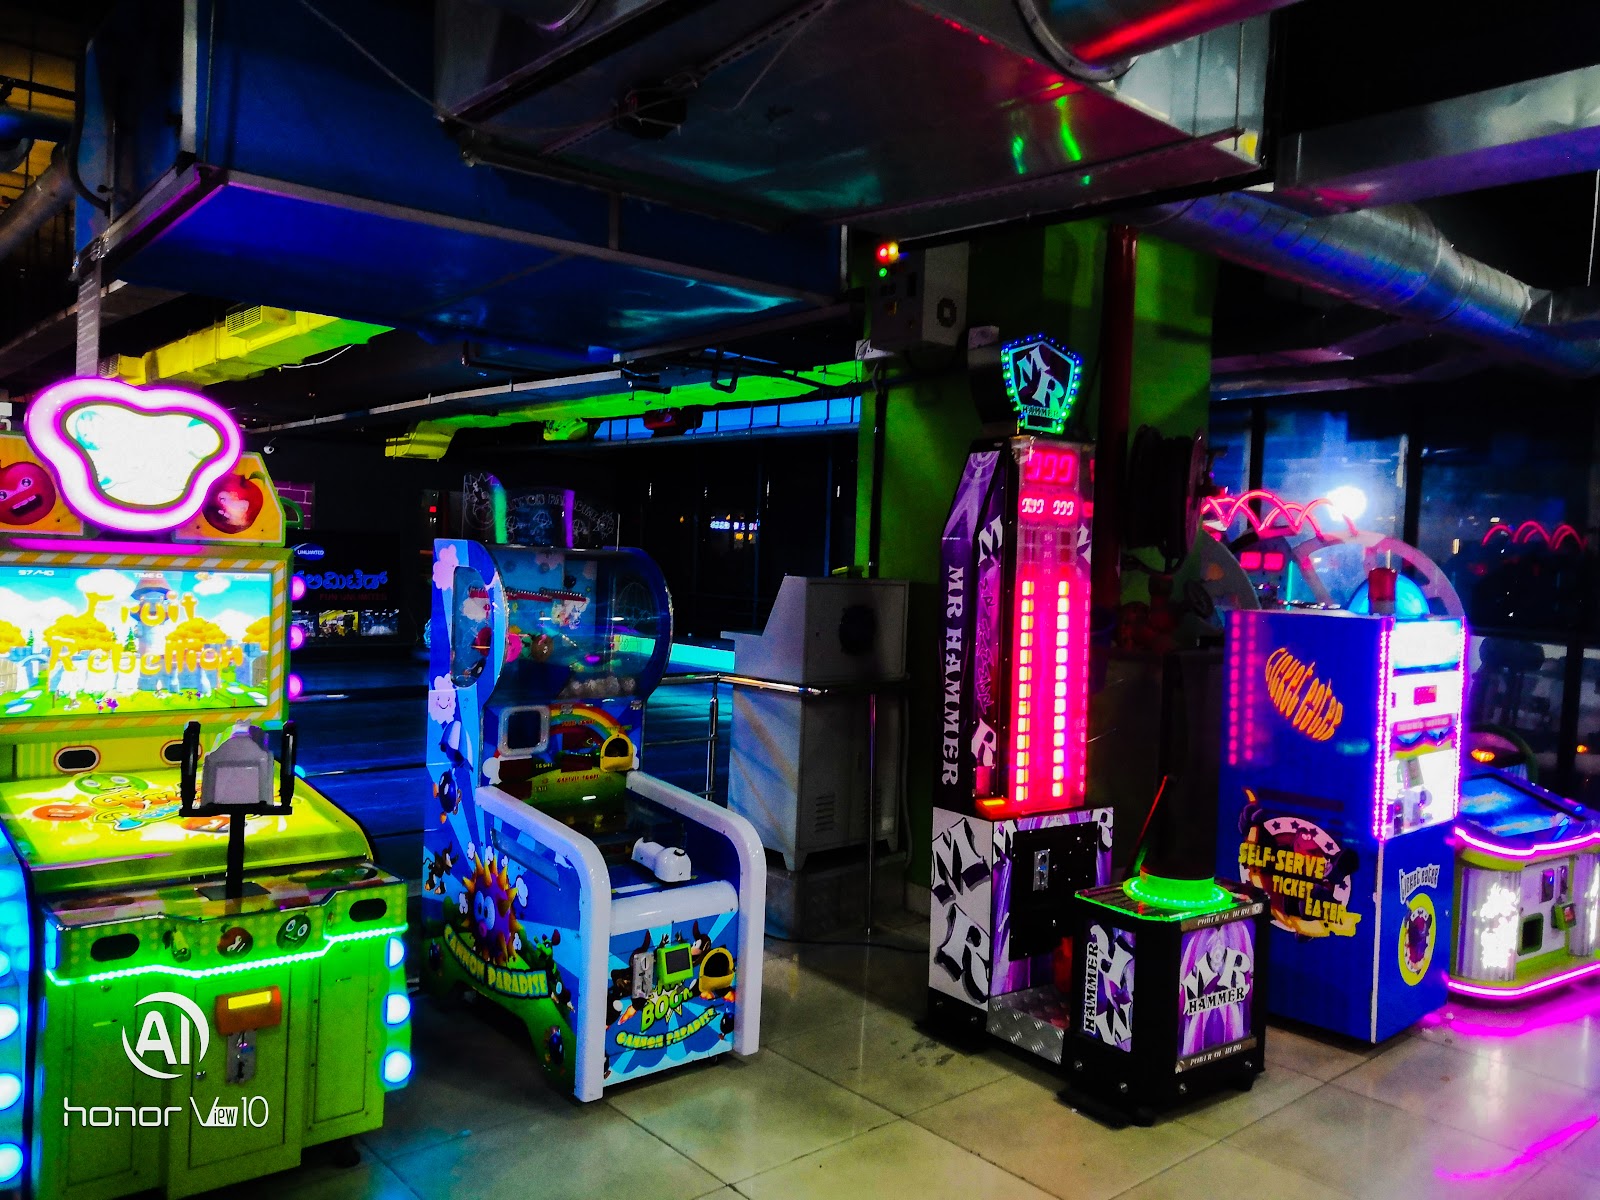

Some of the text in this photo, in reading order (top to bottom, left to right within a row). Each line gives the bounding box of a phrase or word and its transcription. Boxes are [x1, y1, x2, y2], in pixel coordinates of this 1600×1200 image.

[1017, 345, 1064, 413] MR
[85, 591, 199, 627] Fruit
[49, 636, 244, 675] Rebellion
[941, 565, 964, 786] MR HAMMER
[1238, 842, 1326, 880] SELF-SERVE
[1272, 875, 1314, 899] TICKET
[1305, 897, 1347, 925] EATER
[486, 964, 549, 997] PARADISE
[1085, 942, 1099, 1034] HAMMER
[1189, 986, 1245, 1014] HAMMER
[617, 1006, 716, 1050] CANNON PARADISE
